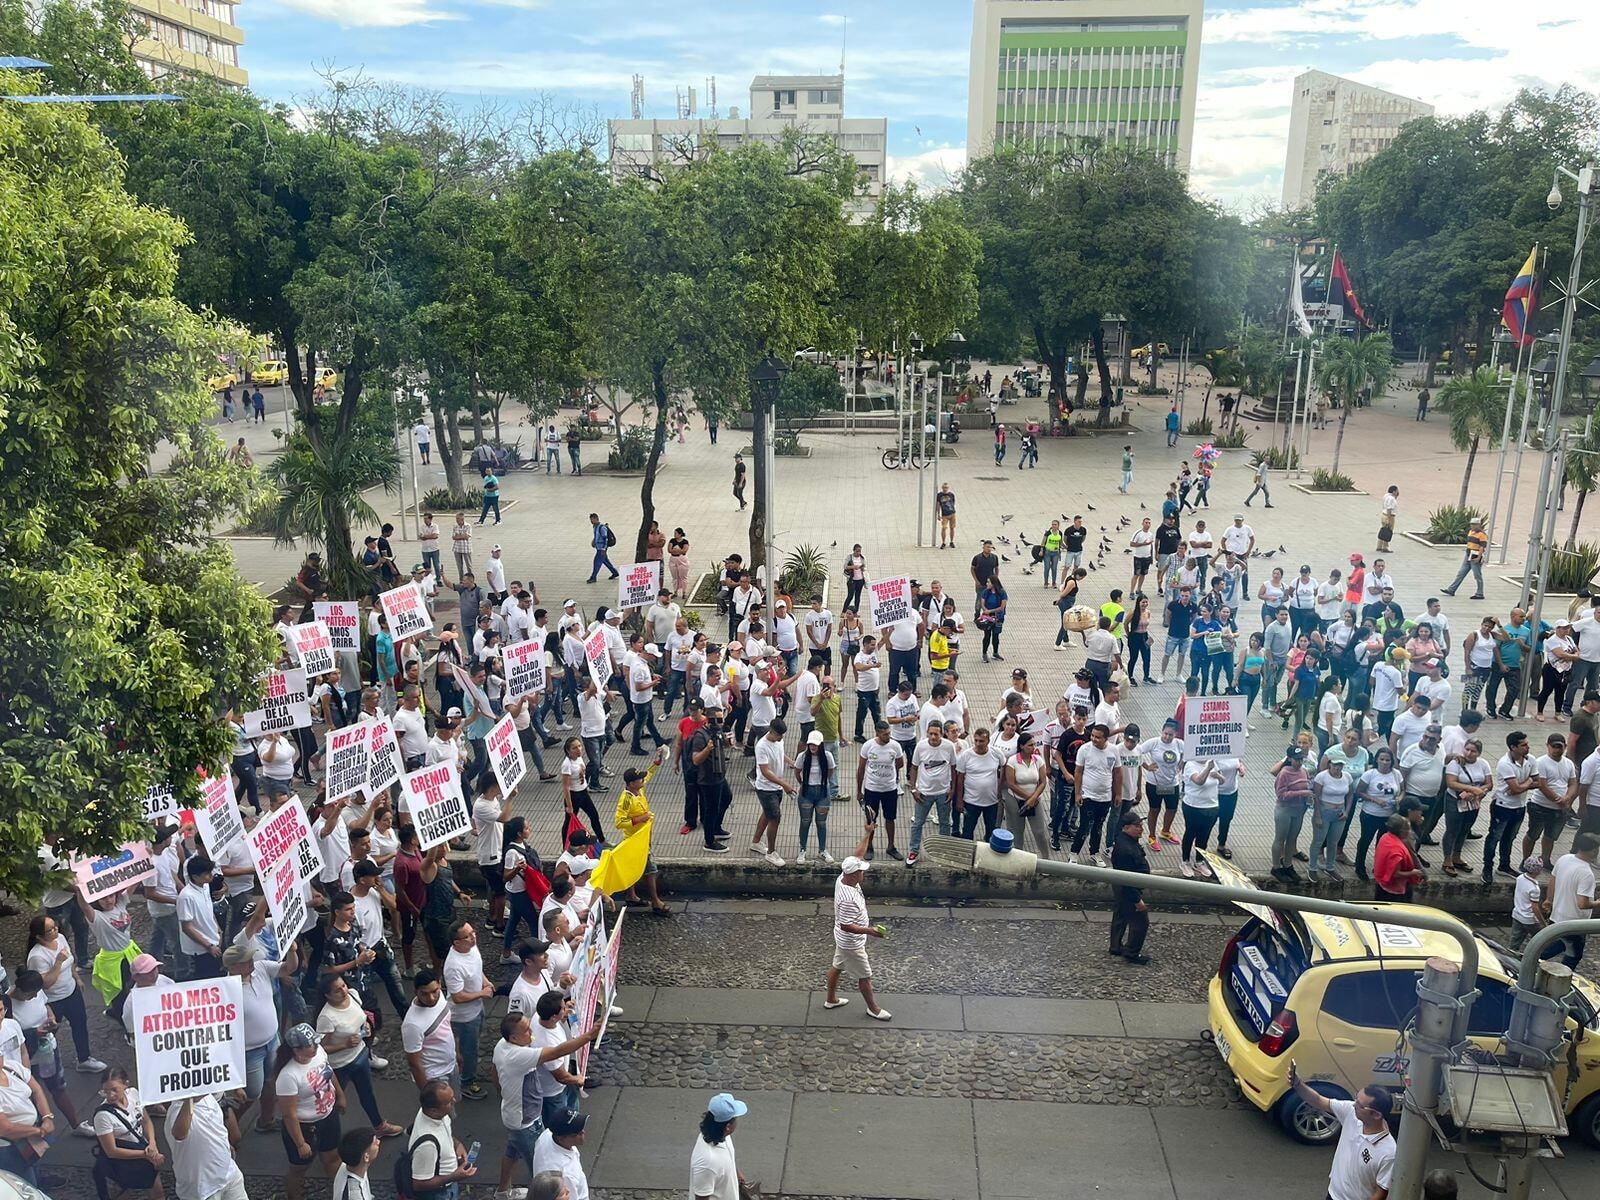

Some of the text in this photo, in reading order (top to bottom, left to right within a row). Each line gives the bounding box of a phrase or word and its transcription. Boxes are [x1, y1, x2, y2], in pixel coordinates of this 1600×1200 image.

[626, 571, 652, 581] EMPRESAS
[634, 566, 647, 574] 1500
[627, 585, 645, 593] TENIDO
[872, 580, 898, 591] DERECHO
[877, 585, 902, 595] TRABAJO
[393, 587, 417, 603] FAMILIA
[330, 605, 343, 616] LOS
[894, 601, 908, 610] ESTA
[398, 609, 417, 624] DE MI
[875, 612, 909, 626] LENTAMENTE
[300, 626, 320, 640] NO MAS
[328, 627, 349, 637] AMOS
[395, 618, 425, 636] TRABAJO
[304, 648, 329, 663] CON EL
[507, 642, 539, 659] EL GREMIO
[306, 658, 332, 675] GREMIO
[512, 660, 538, 676] CALZADO
[520, 655, 528, 664] DE
[509, 669, 542, 687] UNIDO MAS
[510, 677, 543, 696] QUE NUNCA
[265, 706, 289, 719] DE LA
[1203, 701, 1229, 711] ESTAMOS
[261, 716, 294, 731] CIUDAD
[1200, 712, 1230, 723] CANSADOS
[488, 719, 513, 752] LA CIUDAD
[1188, 723, 1242, 734] DE LOS ATROPELLOS
[332, 727, 366, 750] ART. 23
[1200, 734, 1229, 745] CONTRA EL
[334, 743, 364, 763] DERECHO AL
[499, 739, 511, 759] MAS
[1195, 745, 1232, 756] EMPRESARIO.
[329, 758, 352, 776] TRABAJO
[361, 752, 368, 764] LA
[329, 772, 343, 788] LIBRE
[329, 773, 366, 799] DE SU TRABAJO
[370, 765, 397, 792] POLITICA
[410, 767, 450, 794] GREMIO
[425, 786, 445, 805] DEL
[143, 796, 169, 815] S.O.S
[417, 797, 460, 826] CALZADO
[253, 805, 297, 848] LA CIUDAD
[420, 811, 468, 843] PRESENTE
[259, 818, 299, 856] CON MAS
[258, 825, 307, 871] DESEMPLEO
[300, 850, 312, 866] DE
[86, 857, 155, 895] FUNDAMENTAL
[161, 987, 220, 1011] NO MAS
[143, 1004, 236, 1034] ATROPELLOS
[152, 1023, 233, 1052] CONTRA EL
[180, 1047, 210, 1069] QUE
[160, 1064, 230, 1093] PRODUCE
